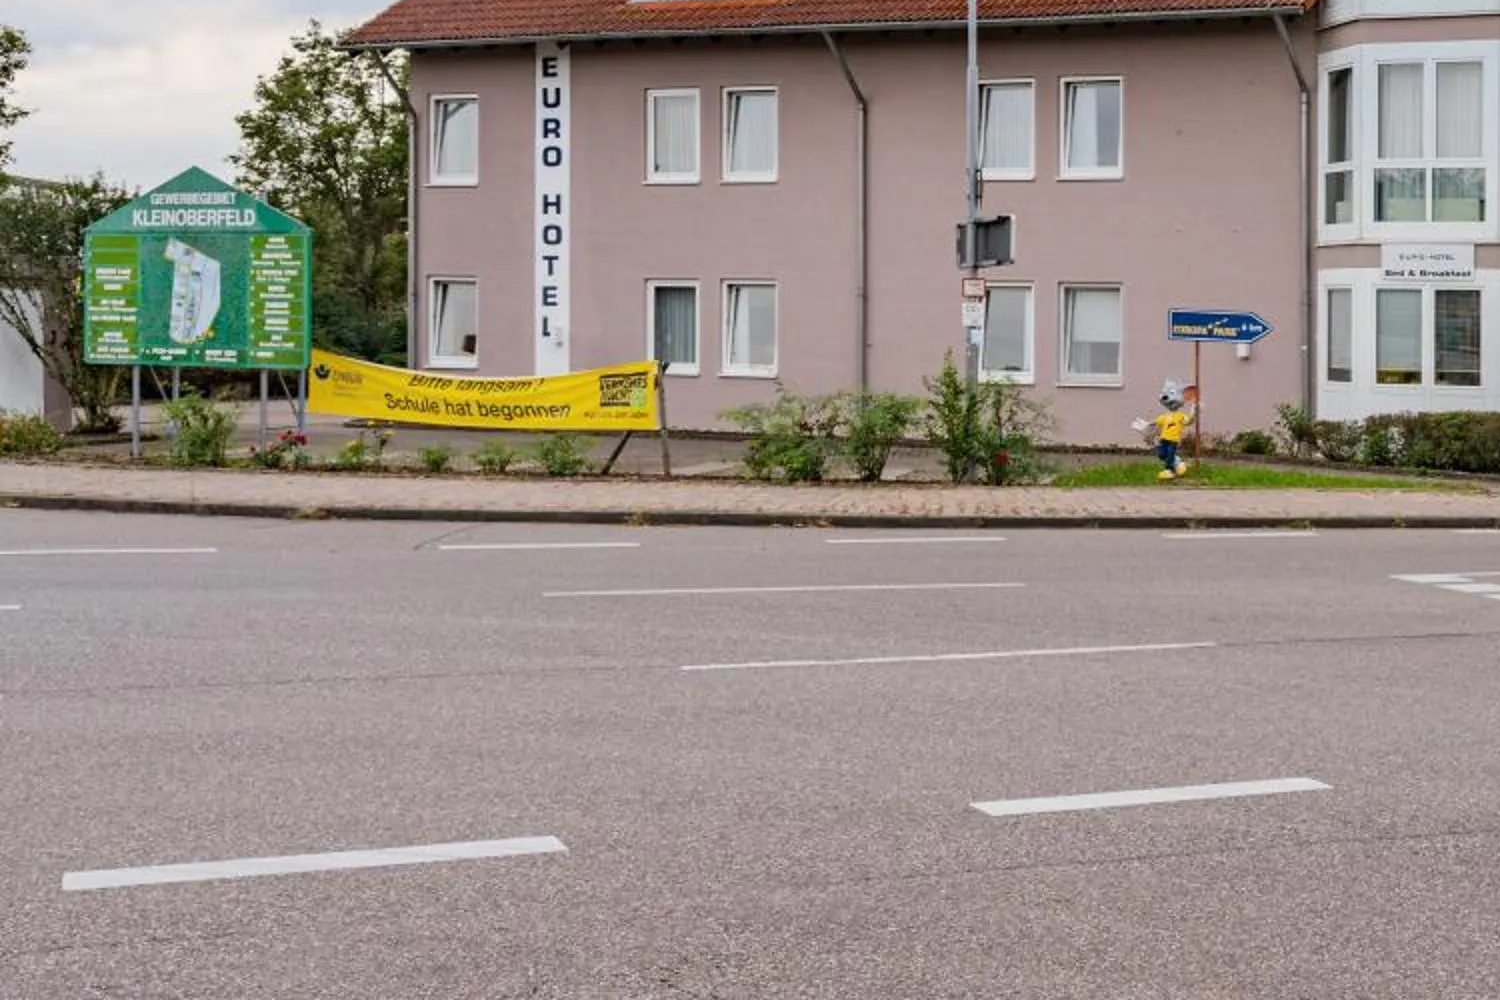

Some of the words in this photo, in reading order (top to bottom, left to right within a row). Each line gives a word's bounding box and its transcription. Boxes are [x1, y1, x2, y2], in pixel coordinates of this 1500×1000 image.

[542, 57, 562, 168] EURO
[133, 209, 256, 226] KLEINOBERFELD
[542, 194, 562, 338] HOTEL
[1408, 269, 1416, 277] &
[1419, 269, 1471, 277] Breakfast
[408, 374, 451, 389] Bitte
[384, 392, 439, 414] Schule
[444, 401, 472, 418] hat
[477, 401, 571, 422] begonnen
